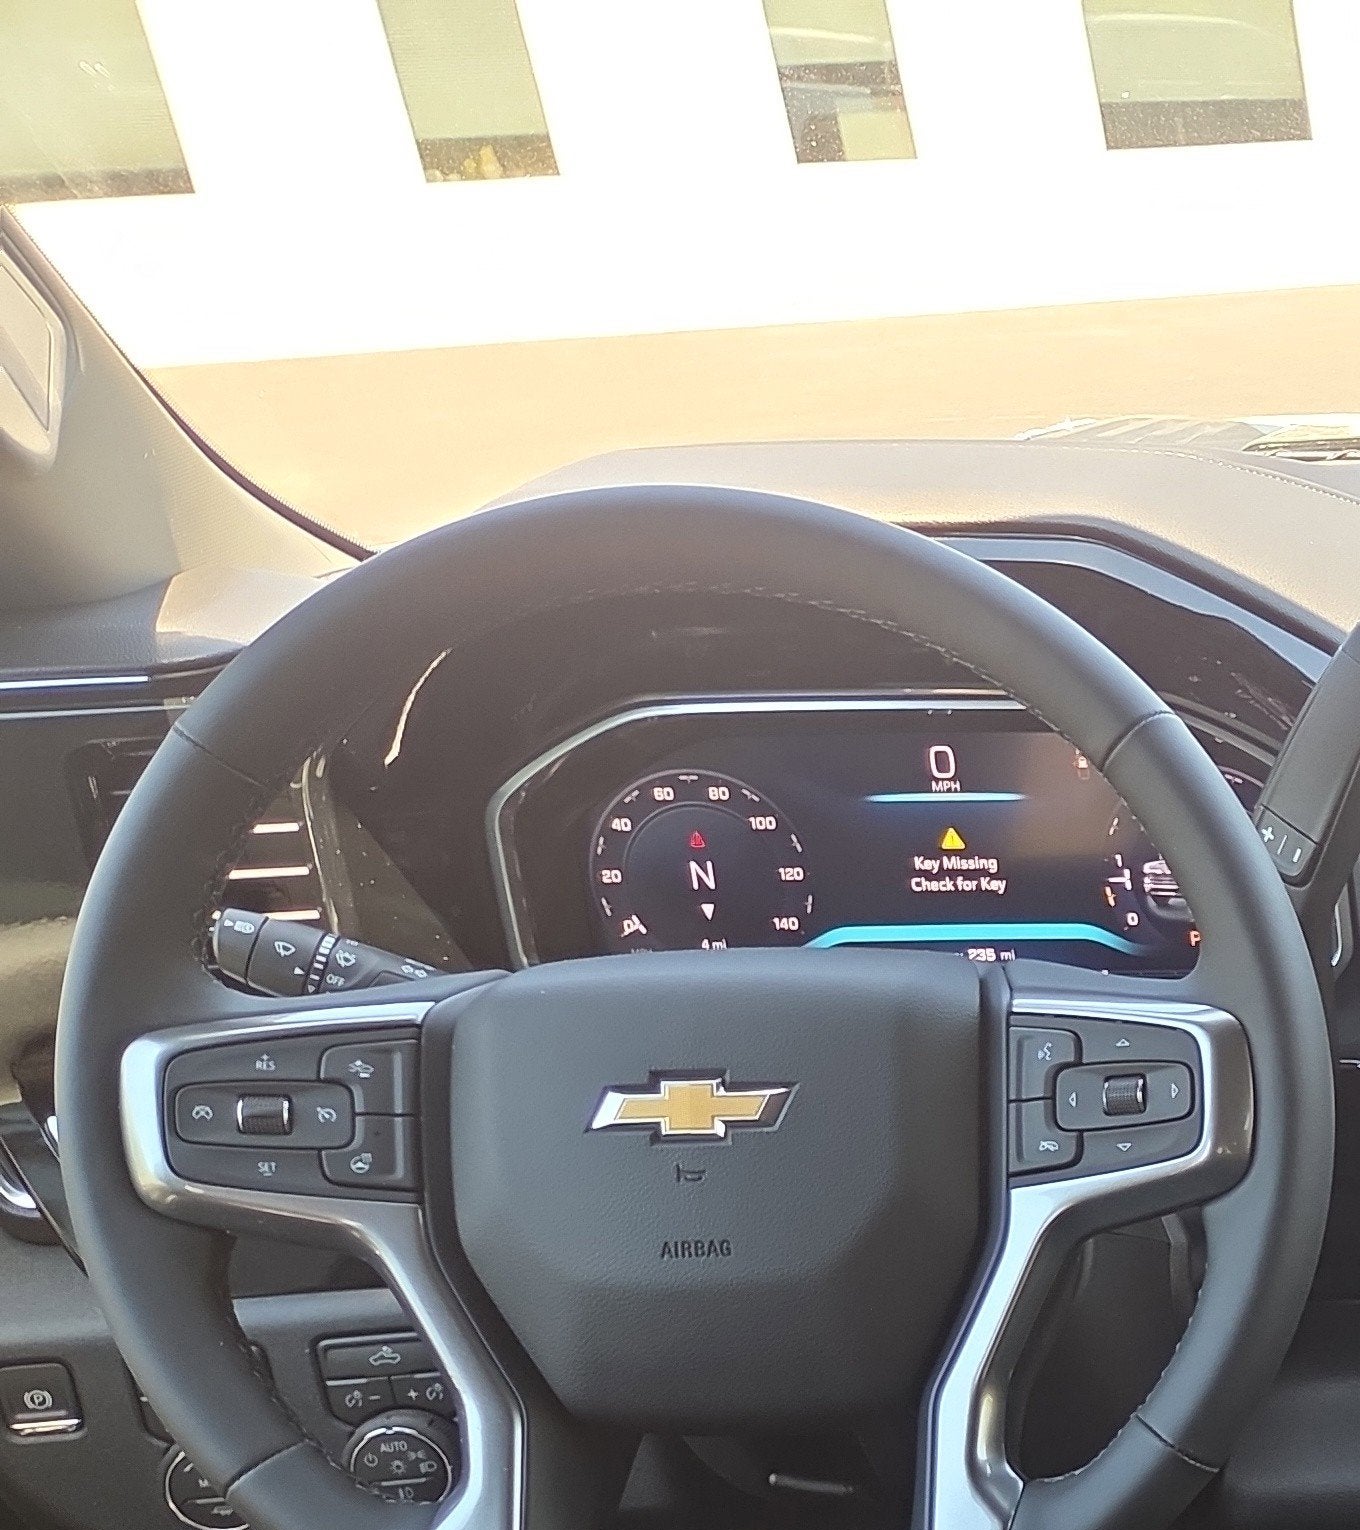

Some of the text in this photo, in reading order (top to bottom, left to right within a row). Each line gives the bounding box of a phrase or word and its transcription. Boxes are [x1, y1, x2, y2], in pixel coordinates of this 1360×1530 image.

[929, 745, 956, 778] 0
[931, 781, 960, 792] MPH
[653, 787, 675, 800] 60
[708, 787, 730, 800] 80
[611, 818, 632, 831] 40
[749, 817, 777, 830] 100
[914, 856, 998, 873] Key Missing
[601, 870, 622, 883] 20
[689, 861, 716, 890] N
[779, 867, 804, 881] 120
[911, 877, 1007, 894] Check for Key
[773, 917, 799, 930] 140
[1126, 912, 1139, 926] 0
[701, 938, 727, 950] 4 mi
[1000, 948, 1015, 961] mi
[326, 973, 346, 987] OFF
[255, 1060, 276, 1071] RES
[258, 1162, 276, 1172] SET
[661, 1239, 732, 1258] AIRBAG
[380, 1441, 407, 1453] AUTO
